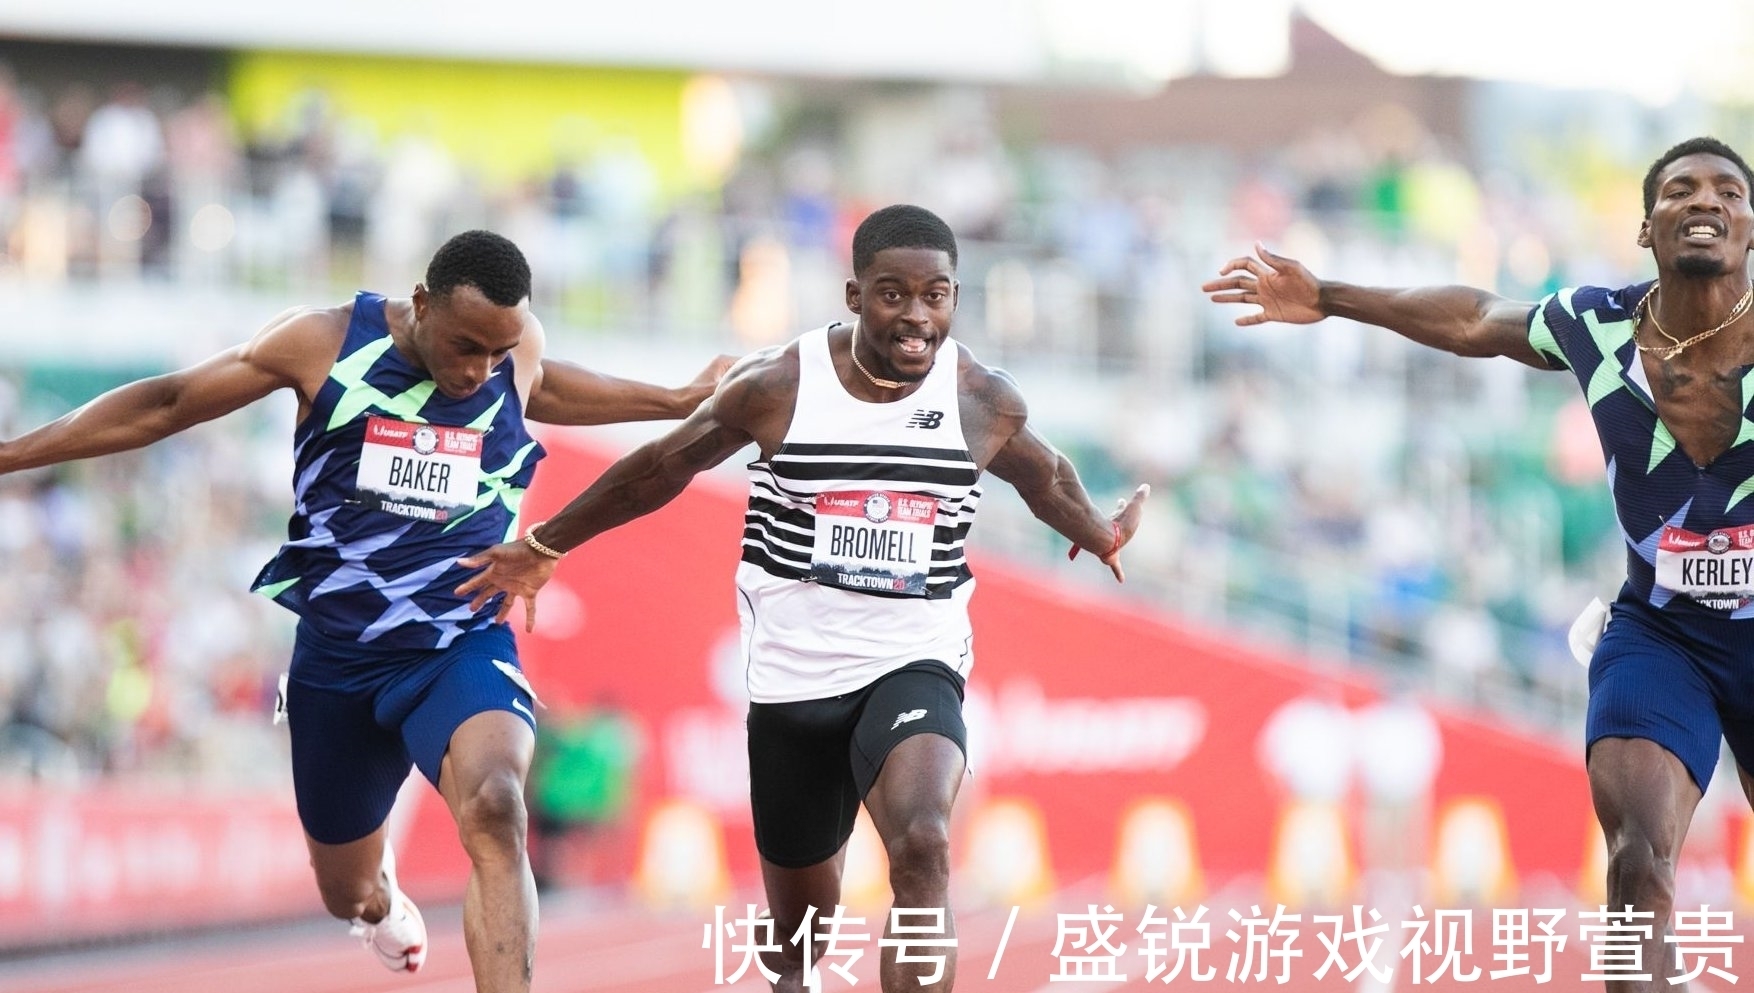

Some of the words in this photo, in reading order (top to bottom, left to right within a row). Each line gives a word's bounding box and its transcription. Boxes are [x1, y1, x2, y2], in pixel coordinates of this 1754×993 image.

[388, 456, 451, 494] BAKER
[830, 524, 917, 564] BROMELL
[1682, 557, 1754, 586] KERLEY
